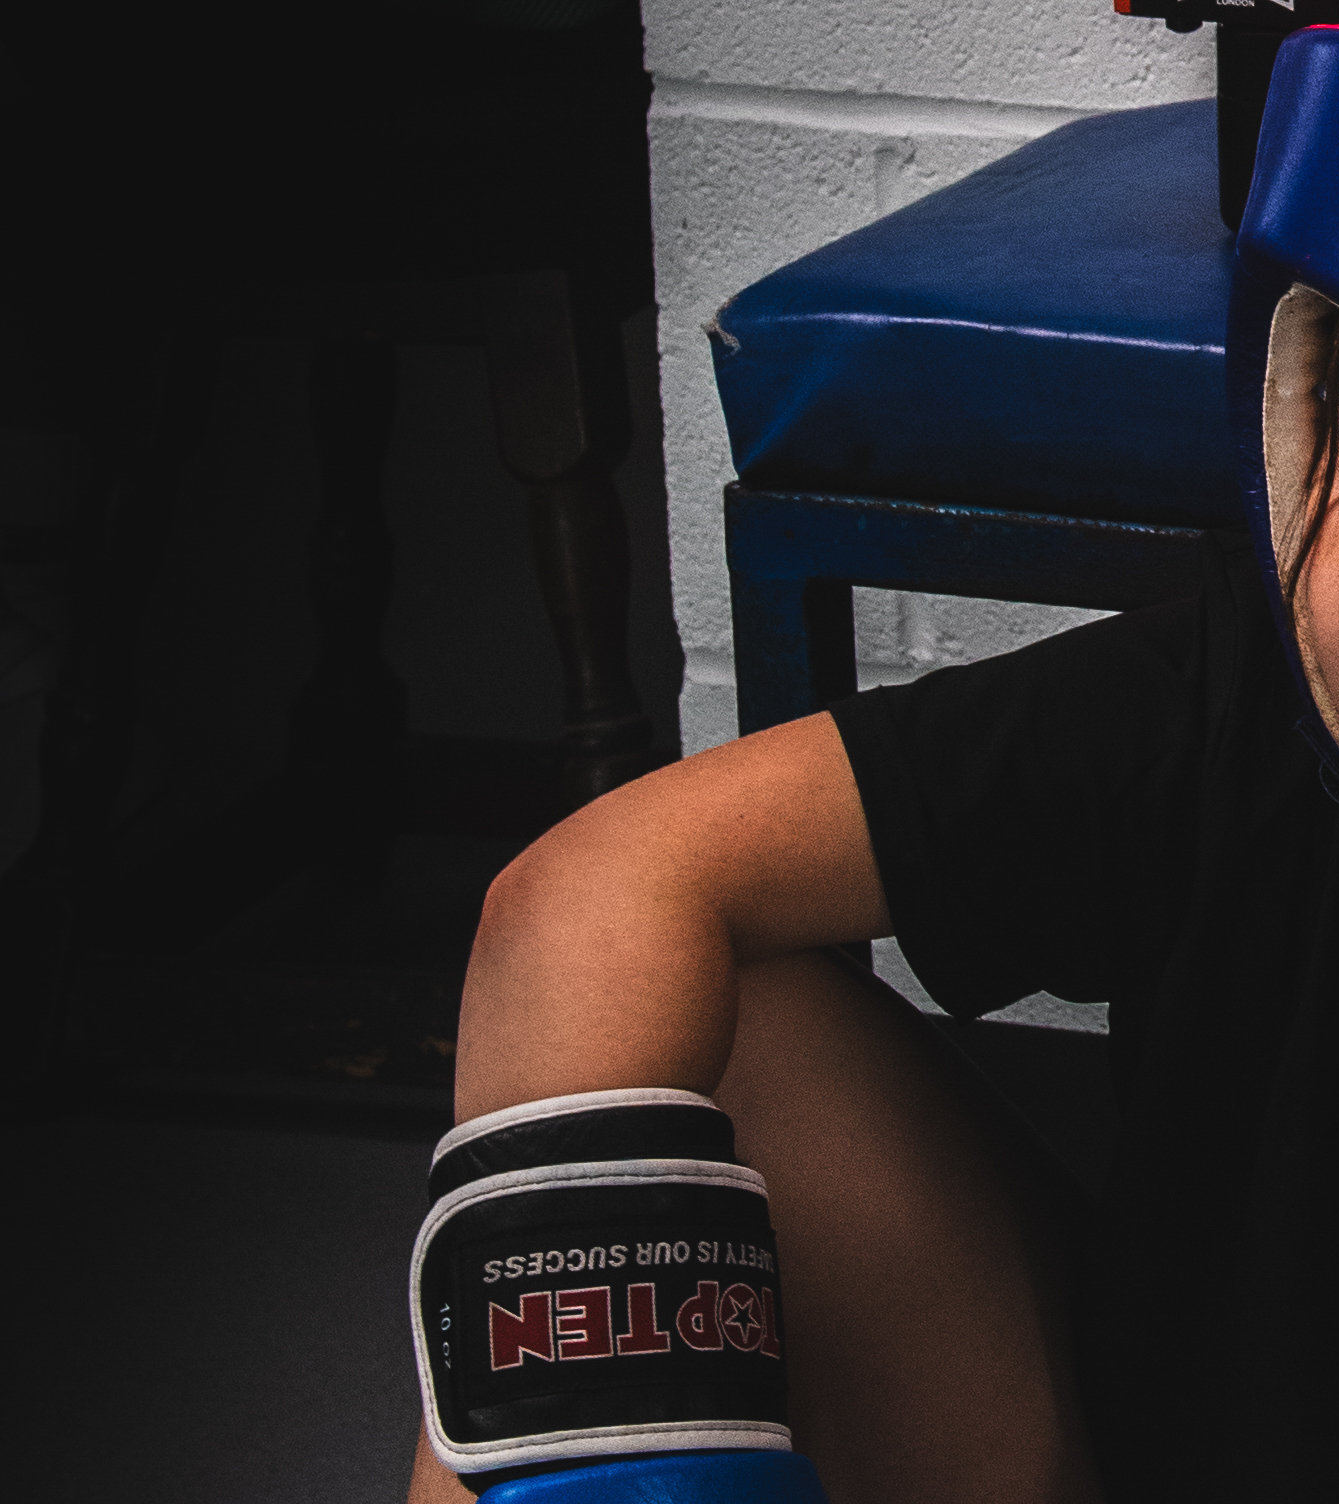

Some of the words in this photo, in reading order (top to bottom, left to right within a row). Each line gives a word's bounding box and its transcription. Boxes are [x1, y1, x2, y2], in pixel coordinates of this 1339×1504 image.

[482, 1243, 629, 1284] SUCCESS
[636, 1241, 690, 1266] OUR
[697, 1241, 719, 1264] IS
[488, 1282, 672, 1372] TEN
[676, 1280, 781, 1360] TOP
